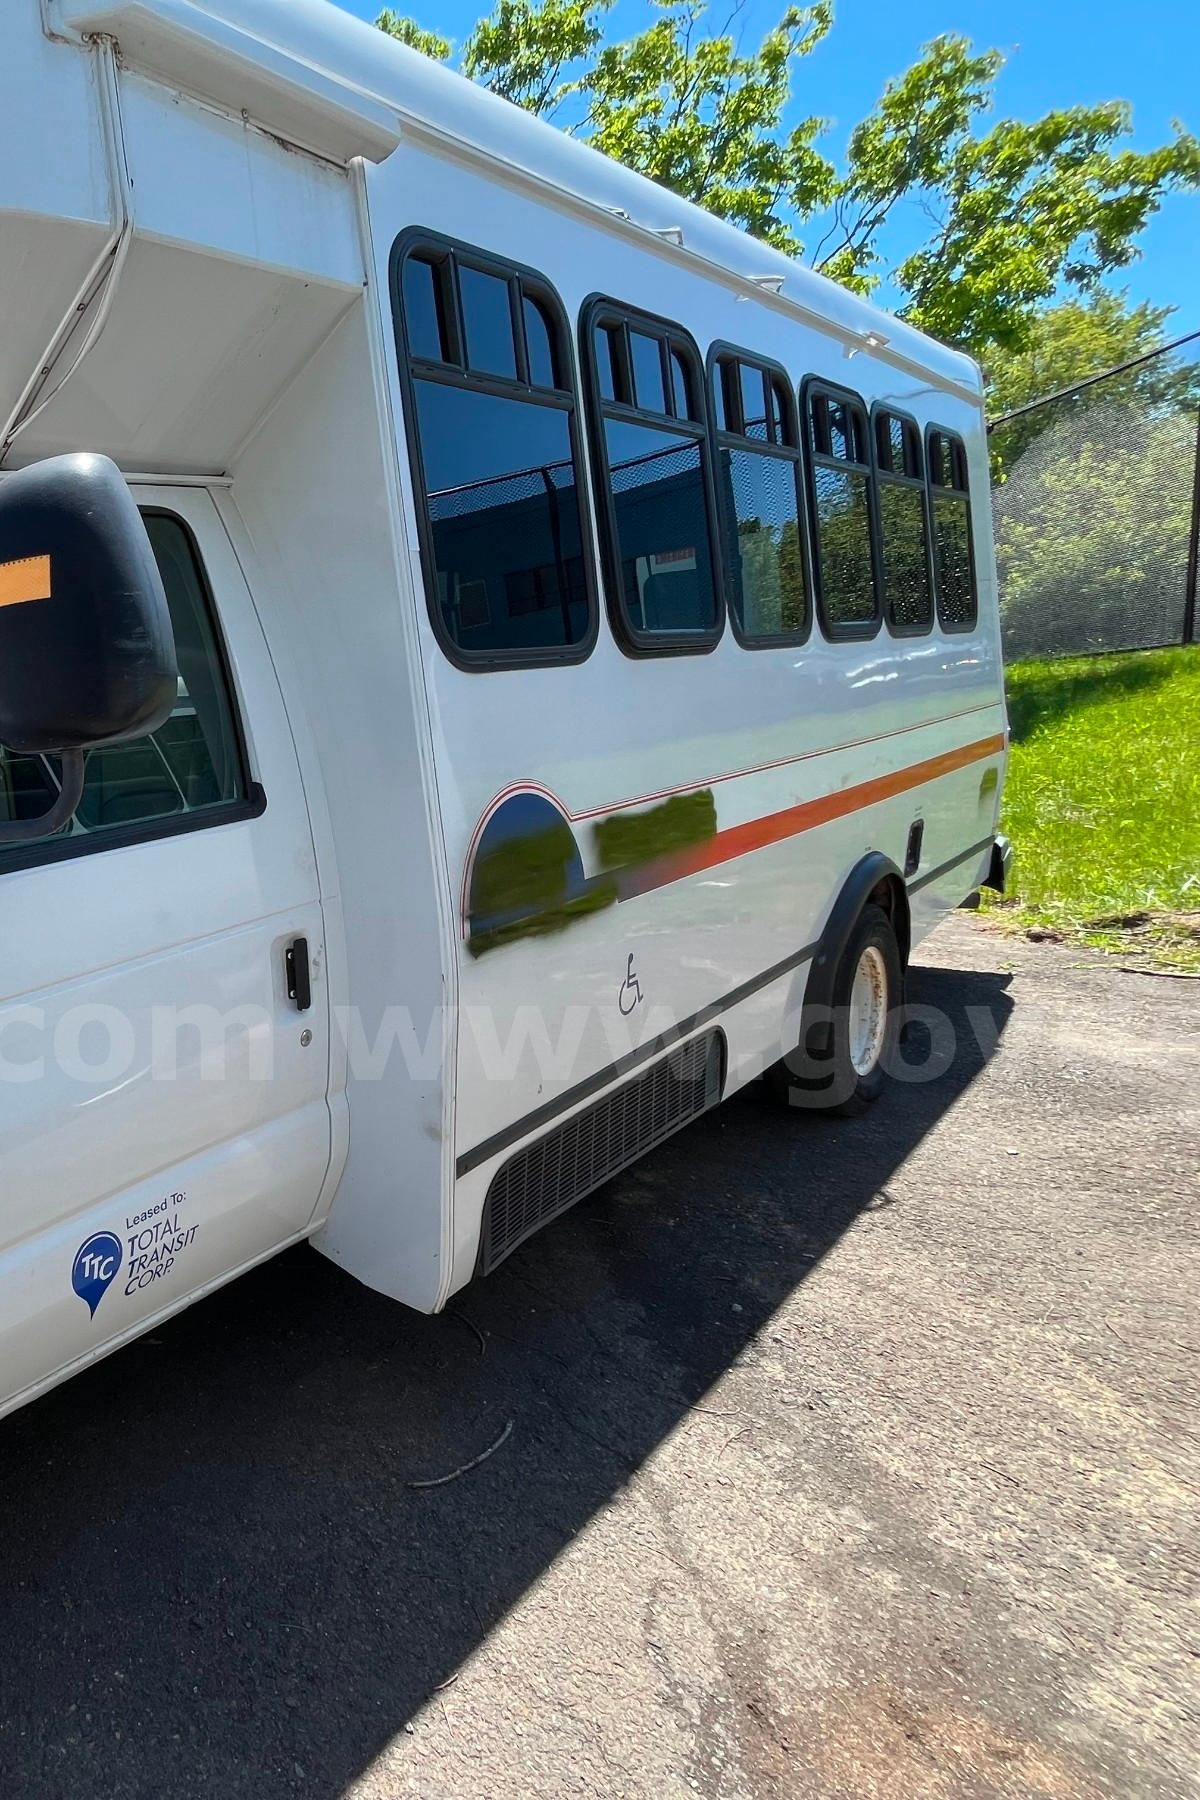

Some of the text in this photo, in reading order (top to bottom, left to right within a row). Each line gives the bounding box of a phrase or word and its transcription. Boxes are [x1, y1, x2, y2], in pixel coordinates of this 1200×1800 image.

[126, 1191, 187, 1230] Leased To:
[127, 1213, 182, 1257] TOTAL
[128, 1224, 200, 1279] TRANSIT
[81, 1252, 114, 1281] TTC
[124, 1257, 175, 1296] CORP.
